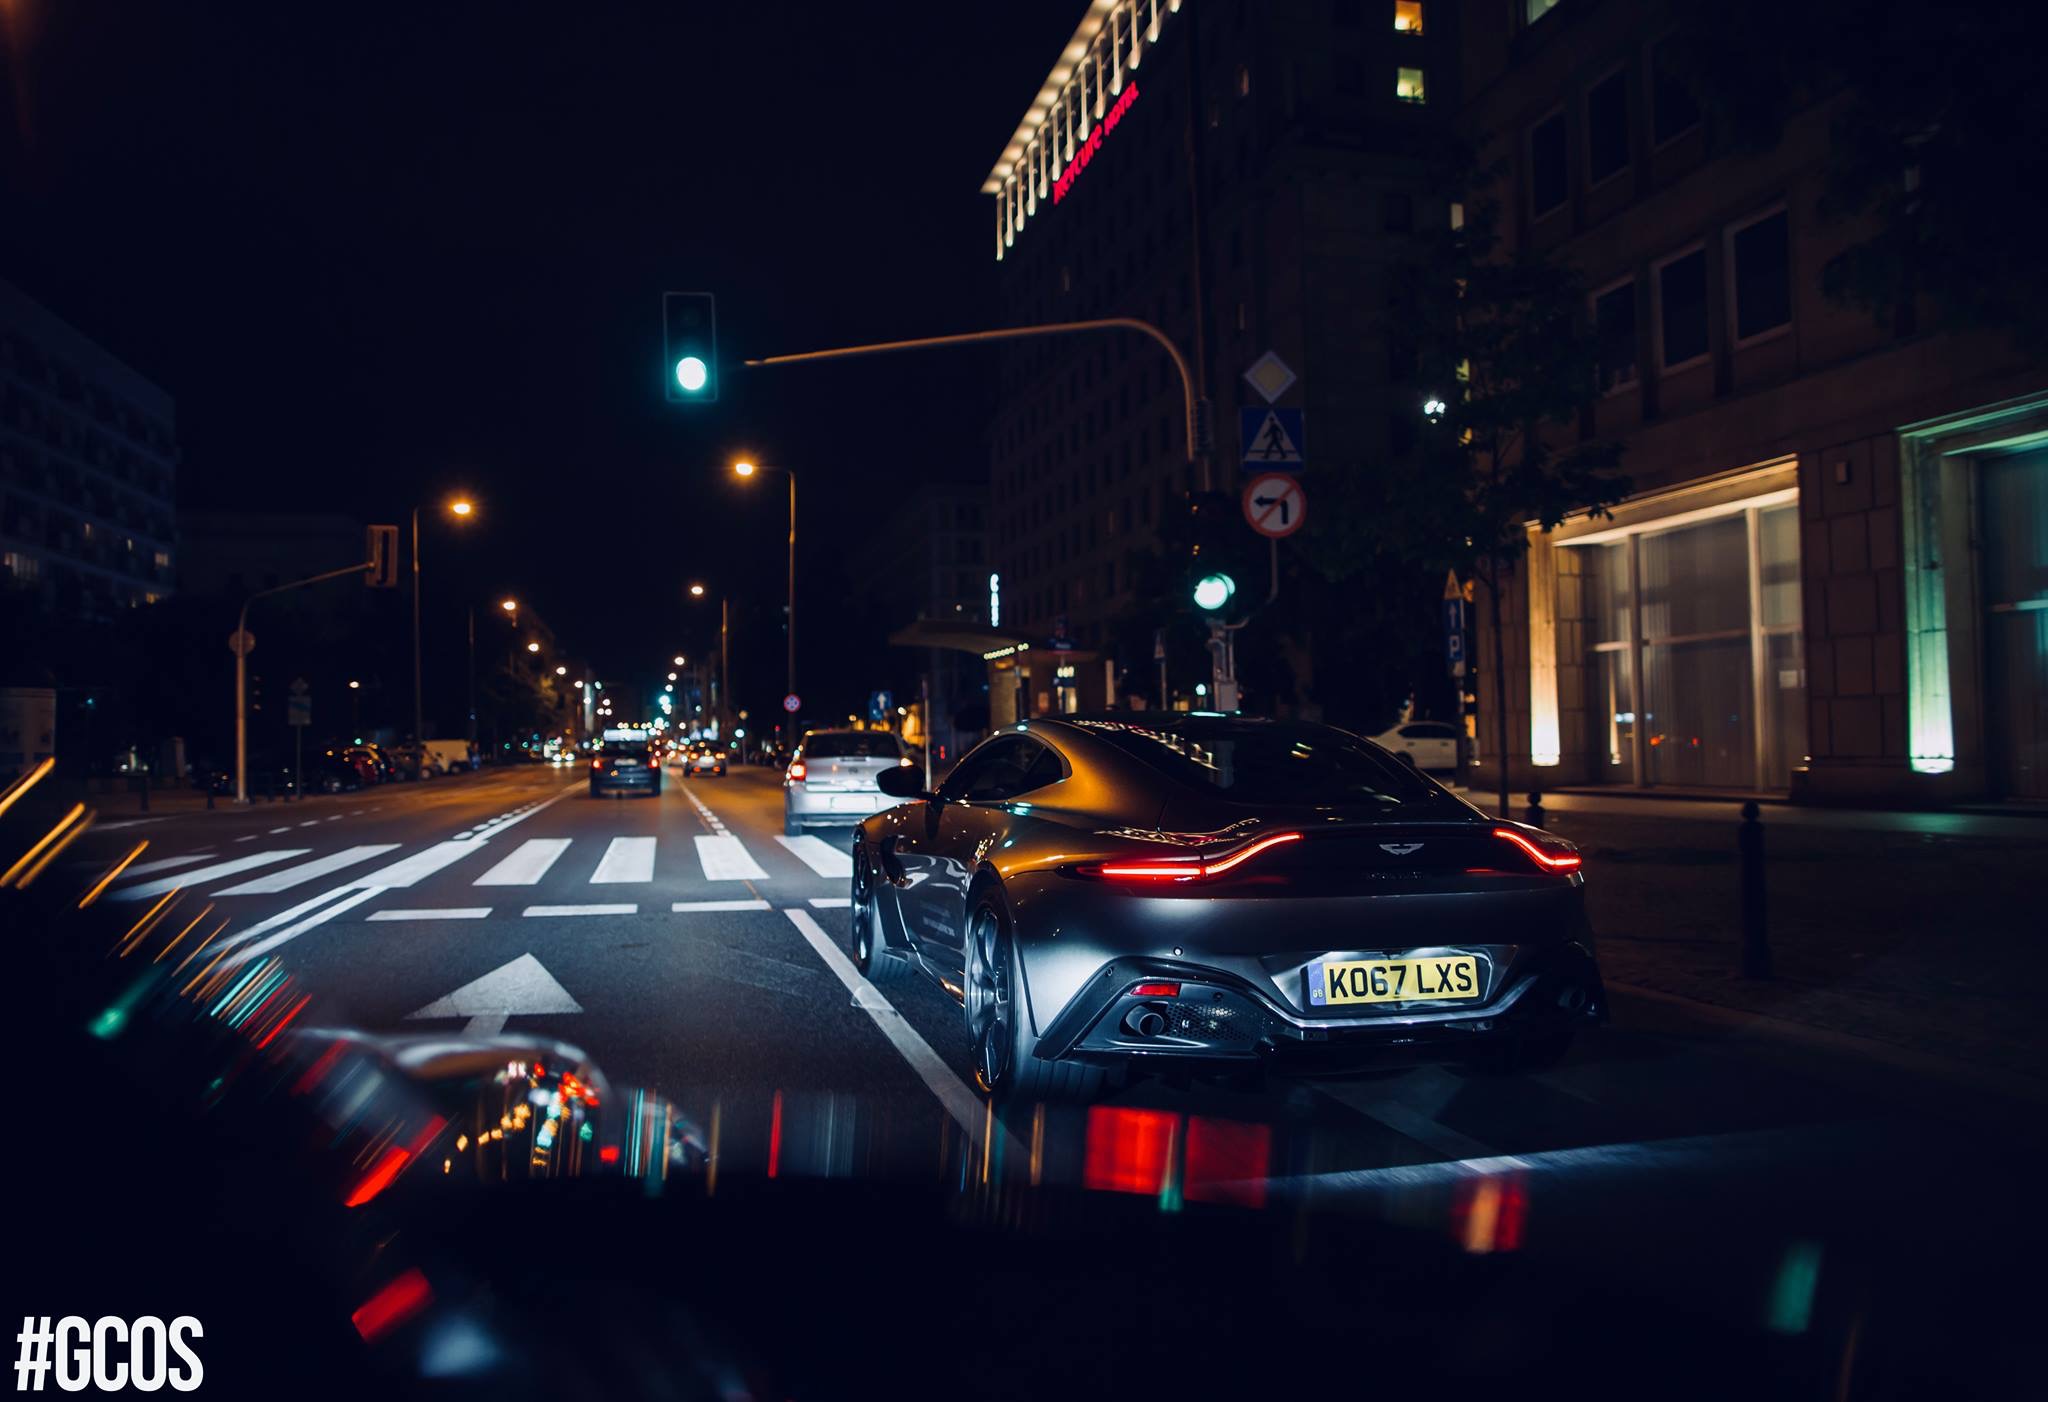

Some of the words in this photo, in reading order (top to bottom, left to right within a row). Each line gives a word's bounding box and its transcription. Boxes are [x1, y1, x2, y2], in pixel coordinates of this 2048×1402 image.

[1448, 635, 1460, 658] P
[1329, 965, 1407, 998] KO67
[1416, 962, 1472, 994] LXS
[1312, 989, 1323, 998] GB
